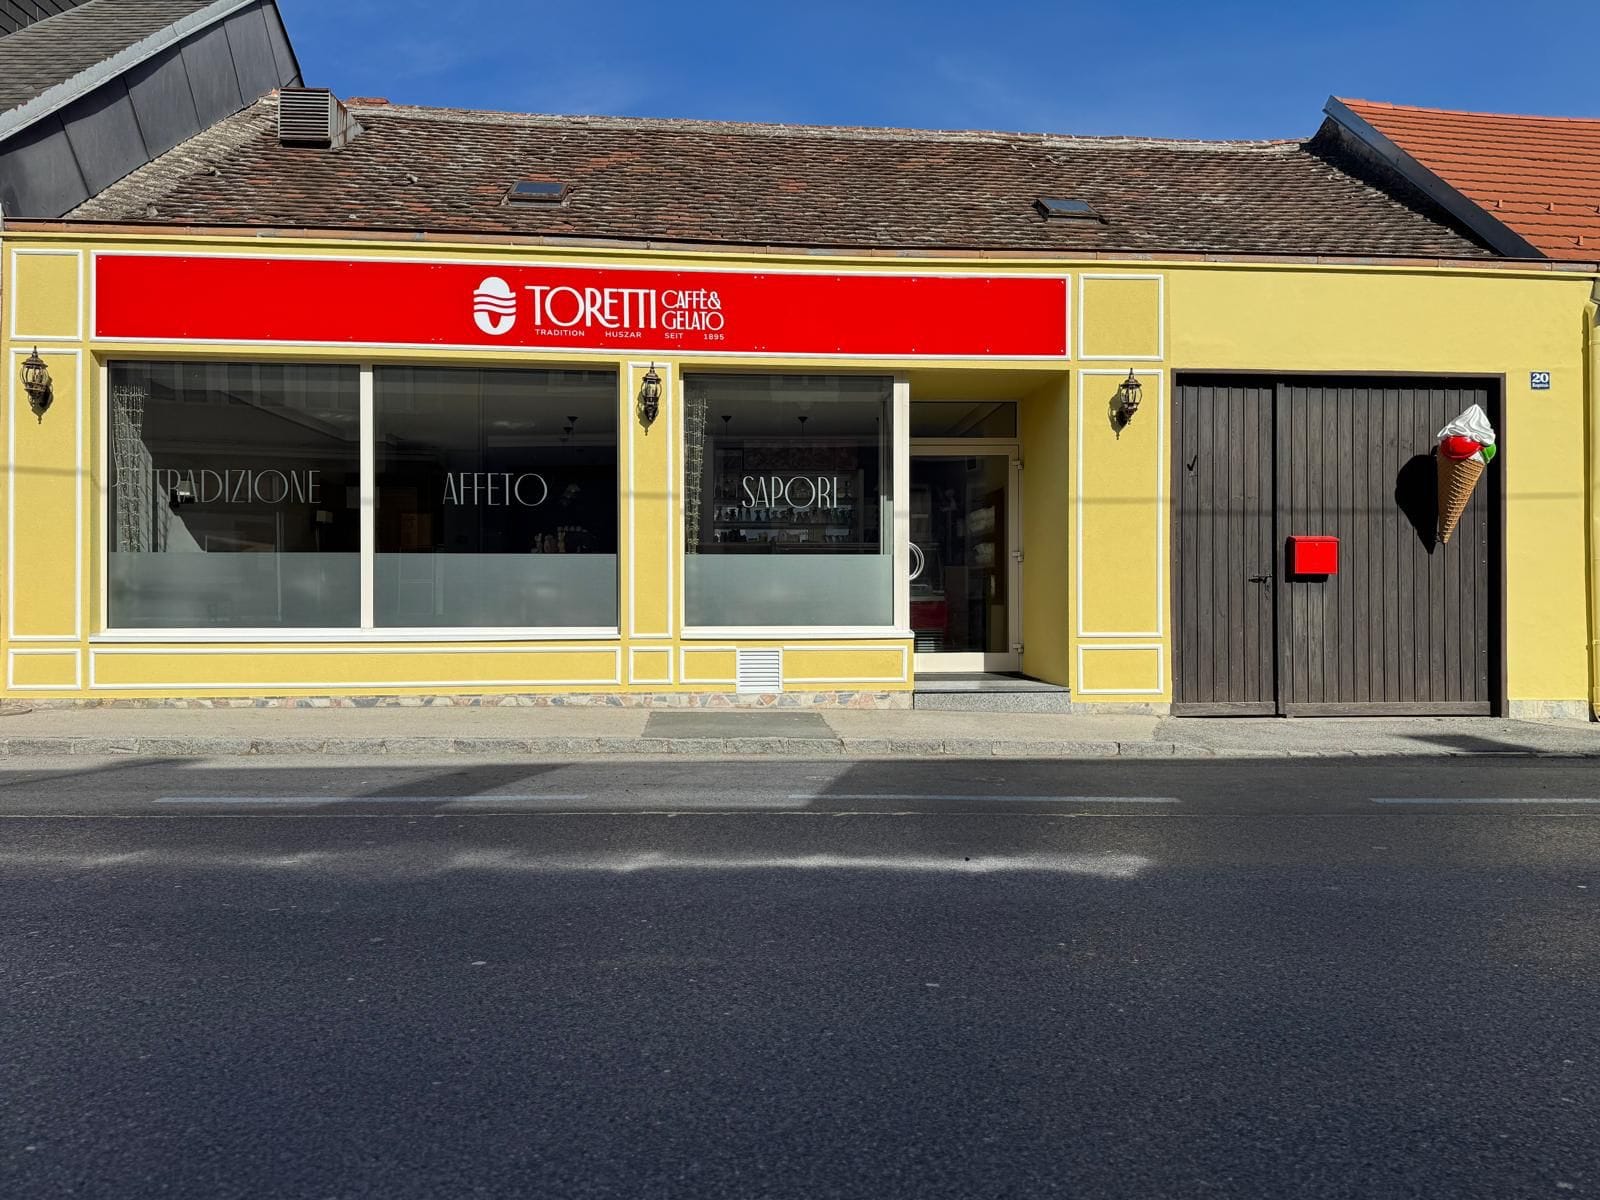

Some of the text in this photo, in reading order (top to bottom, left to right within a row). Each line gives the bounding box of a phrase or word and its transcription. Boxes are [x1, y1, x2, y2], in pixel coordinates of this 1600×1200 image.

[524, 285, 657, 329] TORETTI
[661, 310, 724, 331] GELATO
[534, 328, 725, 341] TRADITION HUSZAR SEIT 1895
[1532, 373, 1549, 383] 20
[150, 469, 321, 504] TRADIZIONE
[442, 472, 548, 507] AFFETO
[741, 475, 838, 509] SAPORI
